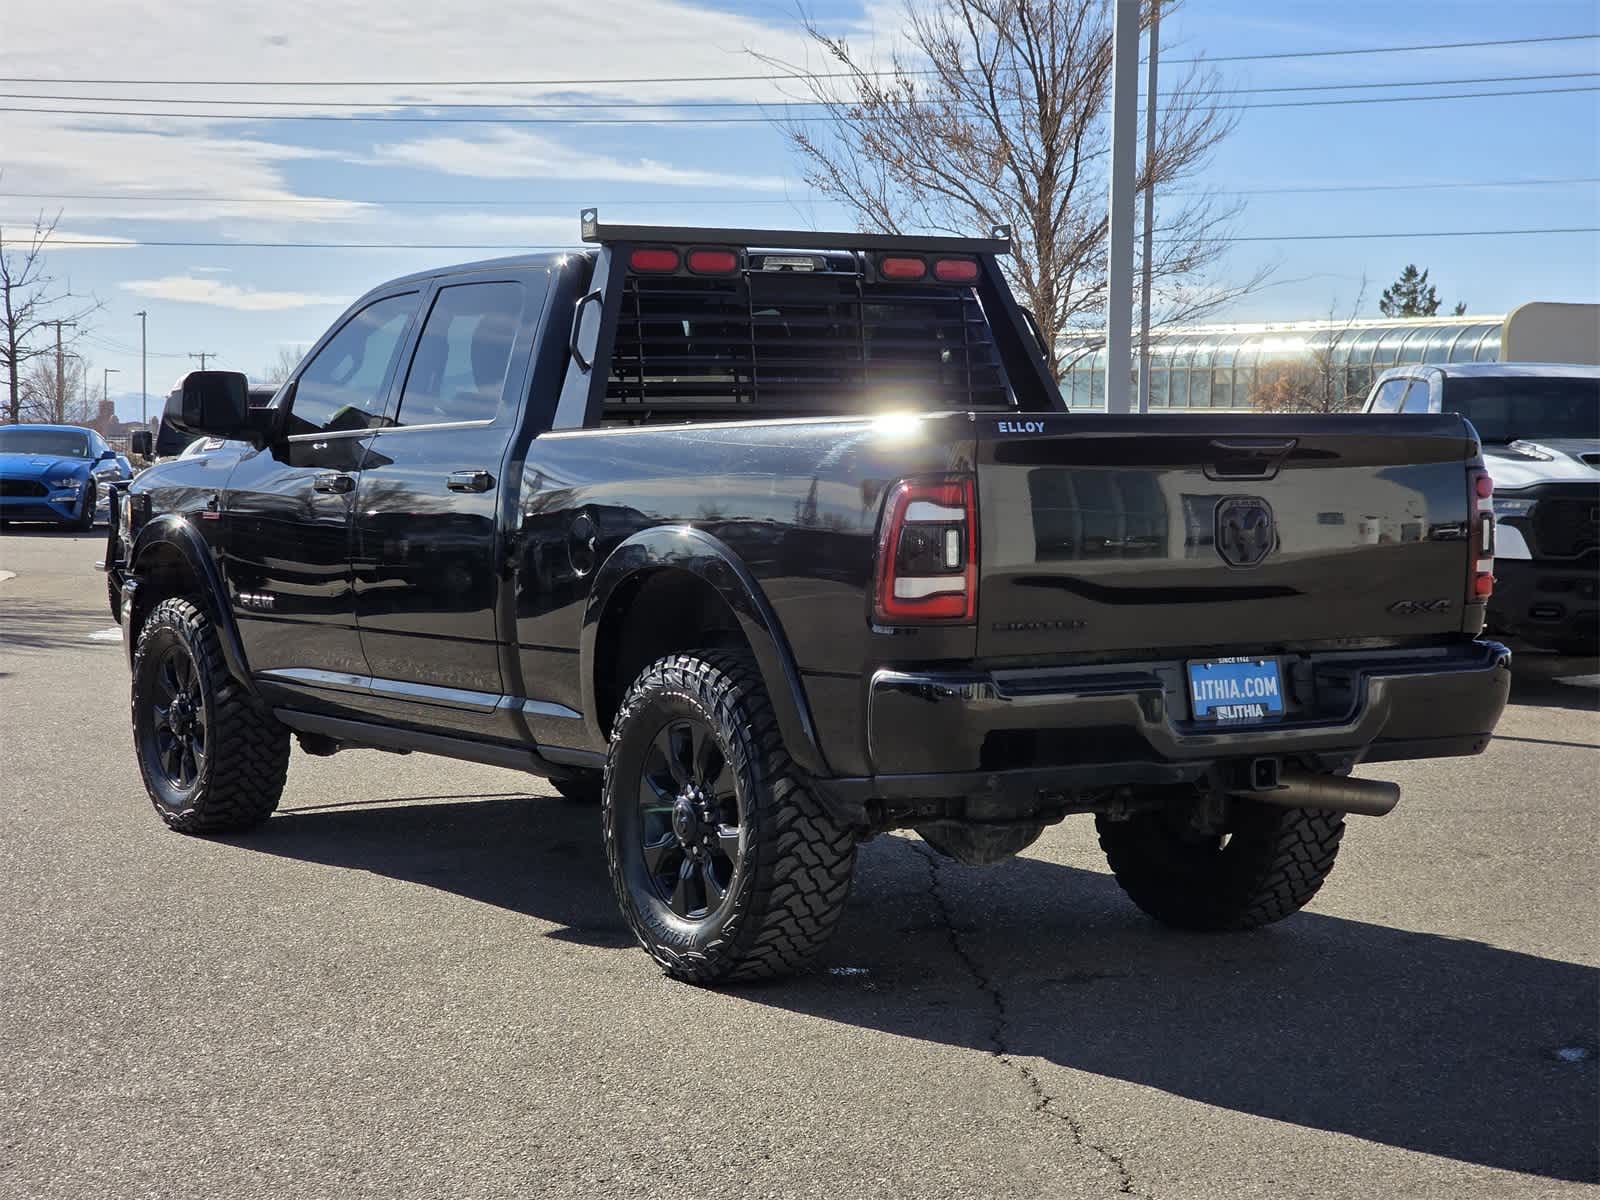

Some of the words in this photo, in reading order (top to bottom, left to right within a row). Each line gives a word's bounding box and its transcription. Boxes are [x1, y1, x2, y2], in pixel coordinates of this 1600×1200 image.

[998, 421, 1045, 433] ELLOY
[1193, 676, 1278, 701] LITHIA.COM
[1227, 703, 1264, 719] LITHIA
